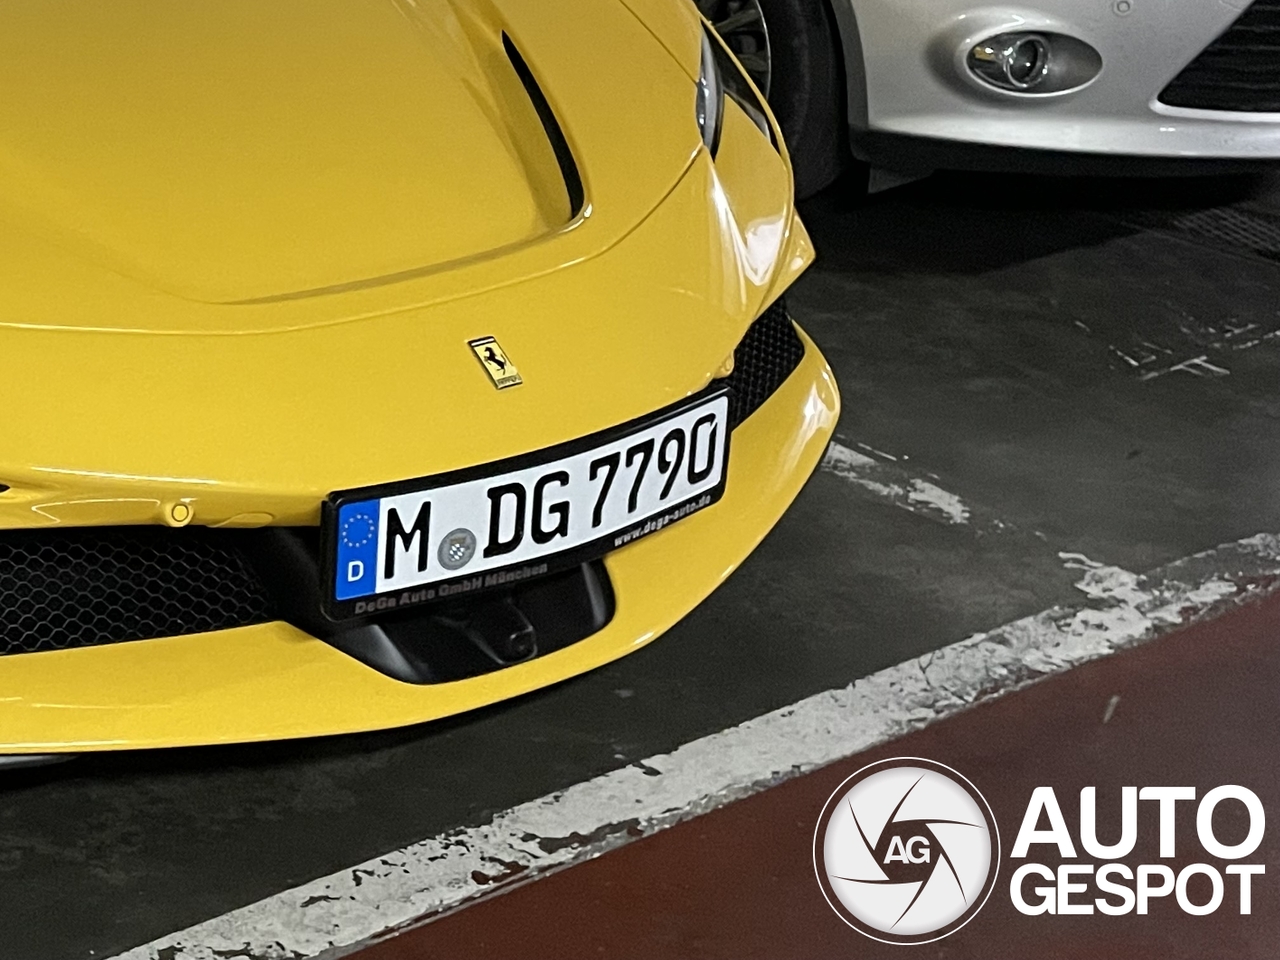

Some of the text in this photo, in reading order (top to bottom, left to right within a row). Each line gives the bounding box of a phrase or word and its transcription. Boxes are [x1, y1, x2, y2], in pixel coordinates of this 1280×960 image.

[383, 412, 717, 580] M DG 7790
[614, 494, 711, 547] www.dega-auto.de
[347, 560, 364, 582] D
[354, 563, 548, 614] DeGa Auto GmbH München
